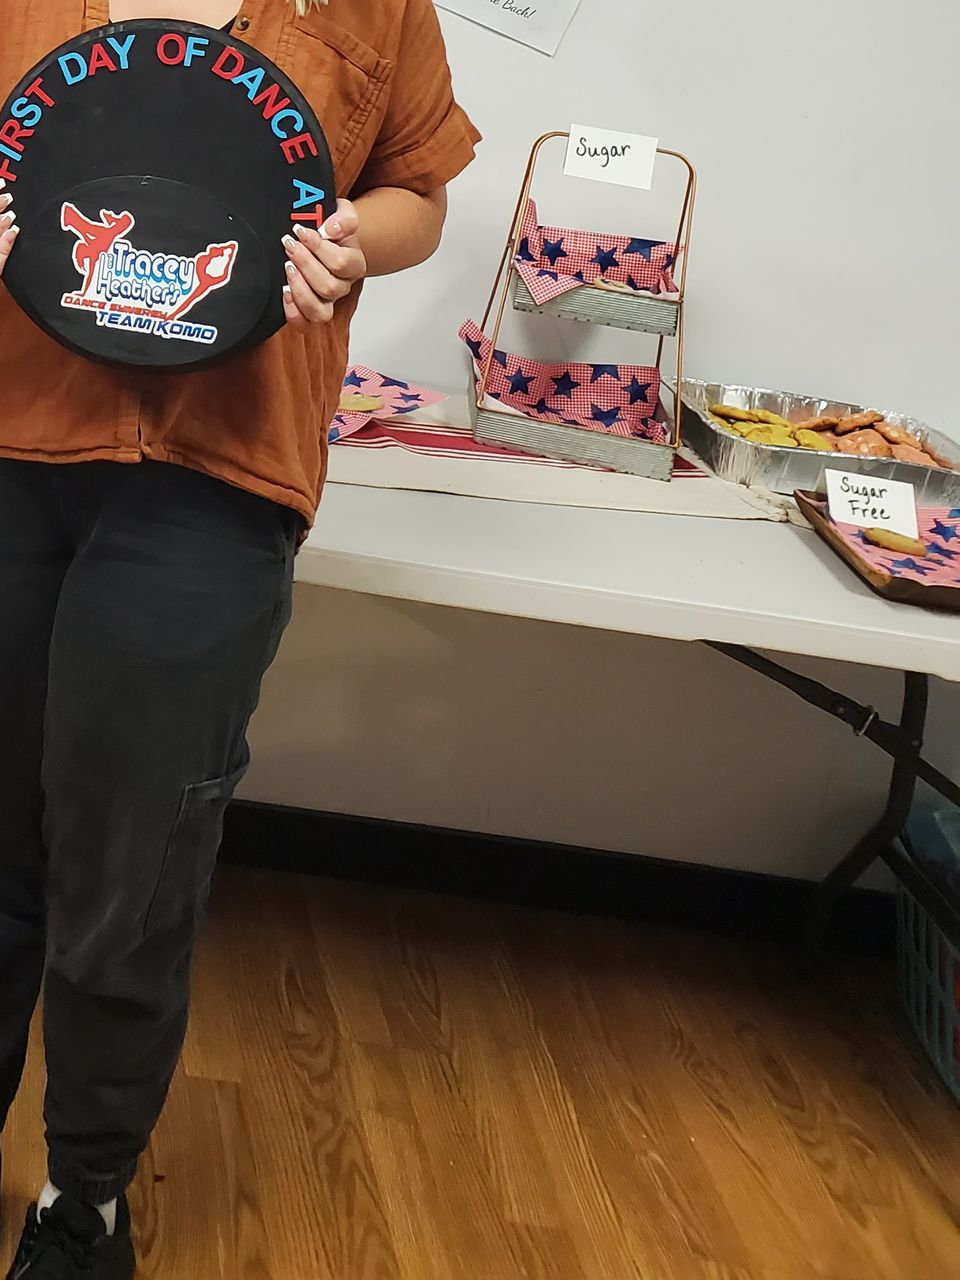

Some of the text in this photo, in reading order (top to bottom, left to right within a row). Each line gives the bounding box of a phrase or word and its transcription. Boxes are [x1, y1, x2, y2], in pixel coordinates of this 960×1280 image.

[57, 34, 136, 86] DAY
[156, 33, 209, 68] OF
[211, 45, 319, 165] DANCE
[290, 178, 325, 229] AT
[575, 135, 632, 169] Sugar
[96, 253, 181, 308] Heather's
[113, 241, 195, 296] Tracey
[64, 296, 107, 310] DANCE
[98, 311, 216, 341] TEAM KOMO
[839, 476, 889, 502] Sugar
[848, 499, 892, 522] Free
